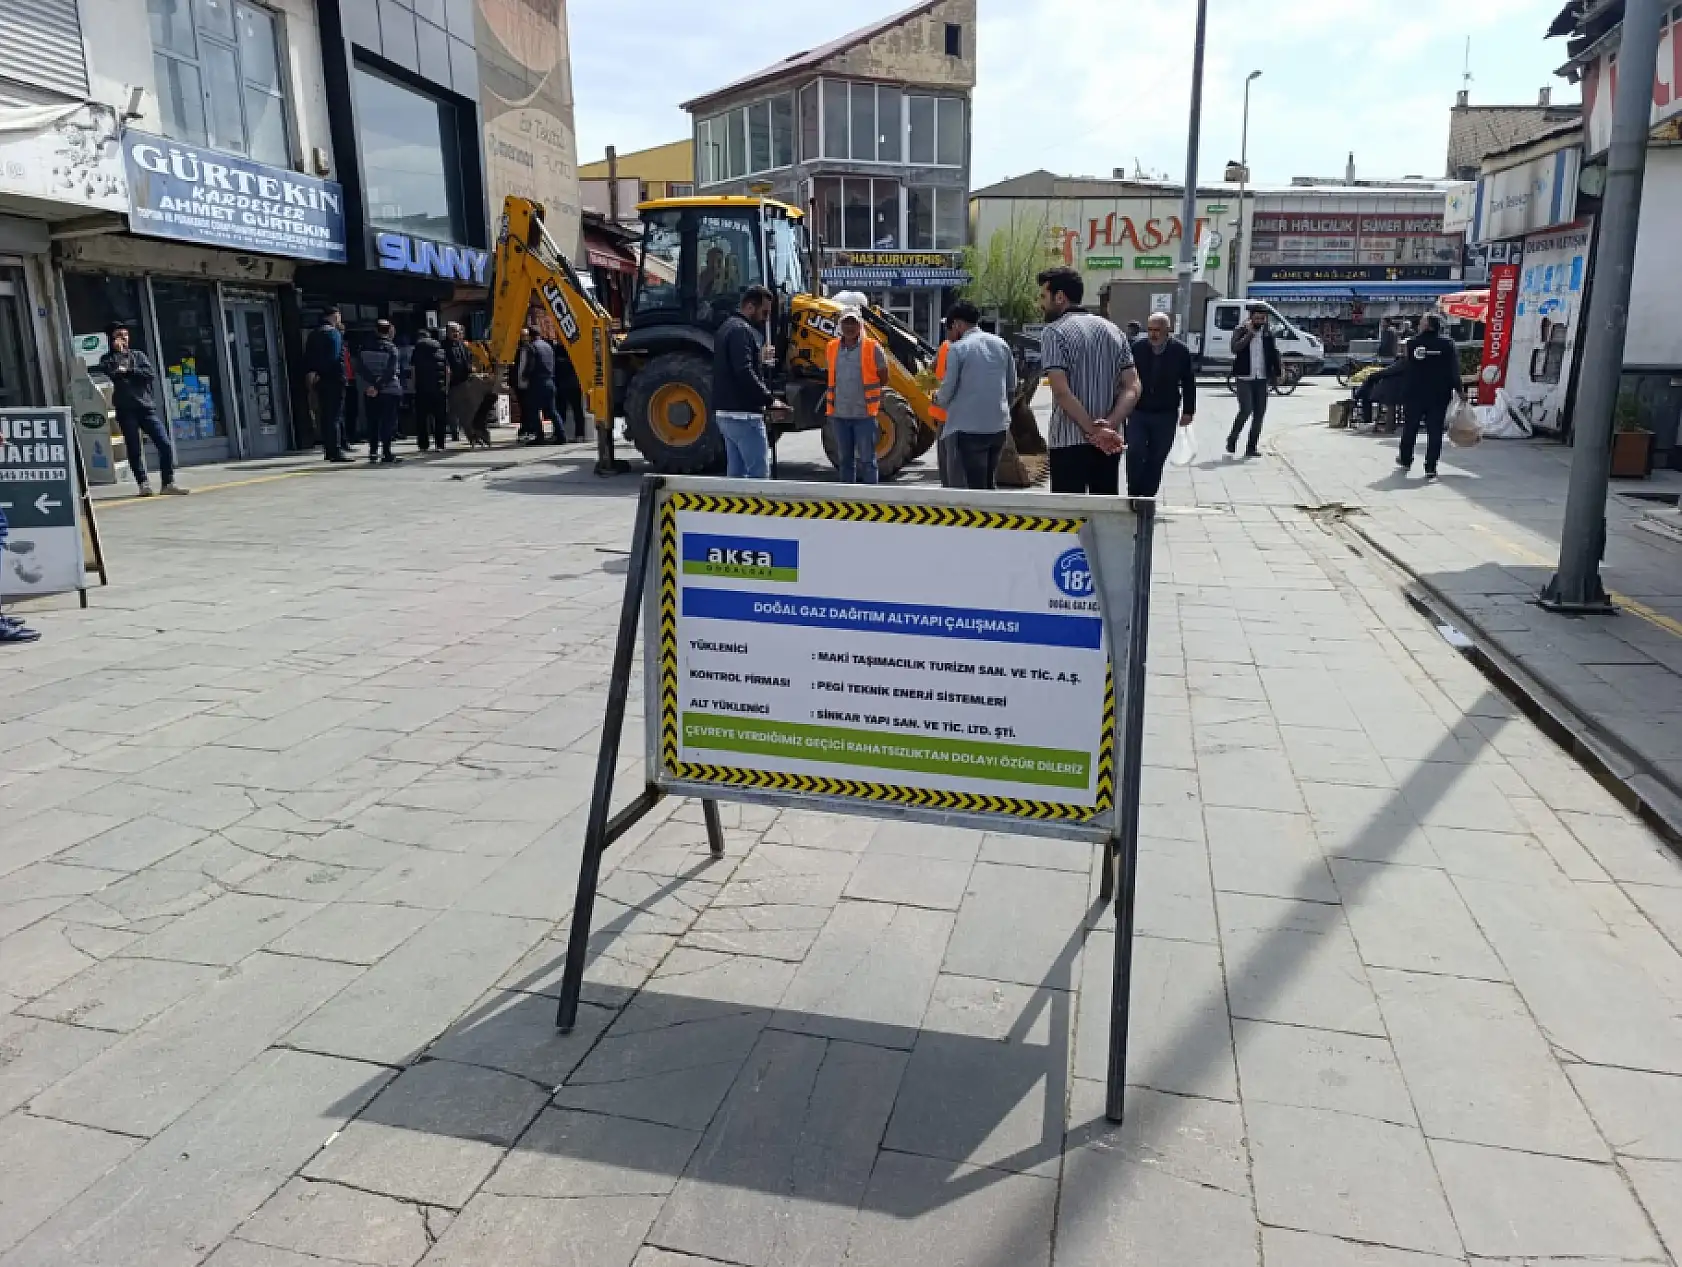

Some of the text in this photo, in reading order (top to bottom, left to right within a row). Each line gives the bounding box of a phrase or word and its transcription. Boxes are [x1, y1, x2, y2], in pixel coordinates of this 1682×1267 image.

[131, 143, 341, 214] GÜRTEKİN
[160, 195, 235, 220] AHMET
[377, 232, 489, 283] SUNNY
[851, 253, 874, 265] HAS
[543, 281, 576, 340] JCB
[1489, 289, 1508, 359] vodafone
[808, 315, 840, 336] JC
[707, 547, 772, 567] aksa
[754, 600, 1020, 634] DOĞAL GAZ DAĞITIM ALTYAPI ÇALIŞMASI
[689, 639, 748, 654] YÜKLENİCİ
[689, 669, 790, 687] KONTROL FİRMASI
[818, 651, 850, 664] MAKİ
[852, 654, 926, 669] TAŞIMACILIK
[930, 660, 975, 675] TURİZM
[978, 665, 1007, 677] SAN.
[1011, 668, 1027, 679] VE
[1030, 668, 1053, 681] TİC.
[1057, 671, 1081, 685] A.Ş.
[689, 699, 770, 714] ALT YÜKLENİCİ
[817, 681, 844, 693] PEGİ
[847, 683, 890, 696] TEKNİK
[893, 687, 933, 701] ENERJİ
[936, 691, 1007, 707] SİSTEMLERİ
[817, 708, 861, 723] SİNKAR
[864, 714, 890, 726] YAPI
[893, 718, 920, 729] SAN.
[923, 720, 939, 730] VE
[942, 720, 964, 733] TİC.
[967, 723, 992, 736] LTD.
[994, 725, 1016, 739] ŞTİ.
[685, 725, 1085, 775] ÇEVREYE VERDİĞİMİZ GEÇİCİ RAHATSIZLIKTAN DOLAYI ÖZÜR DİLERİZ
